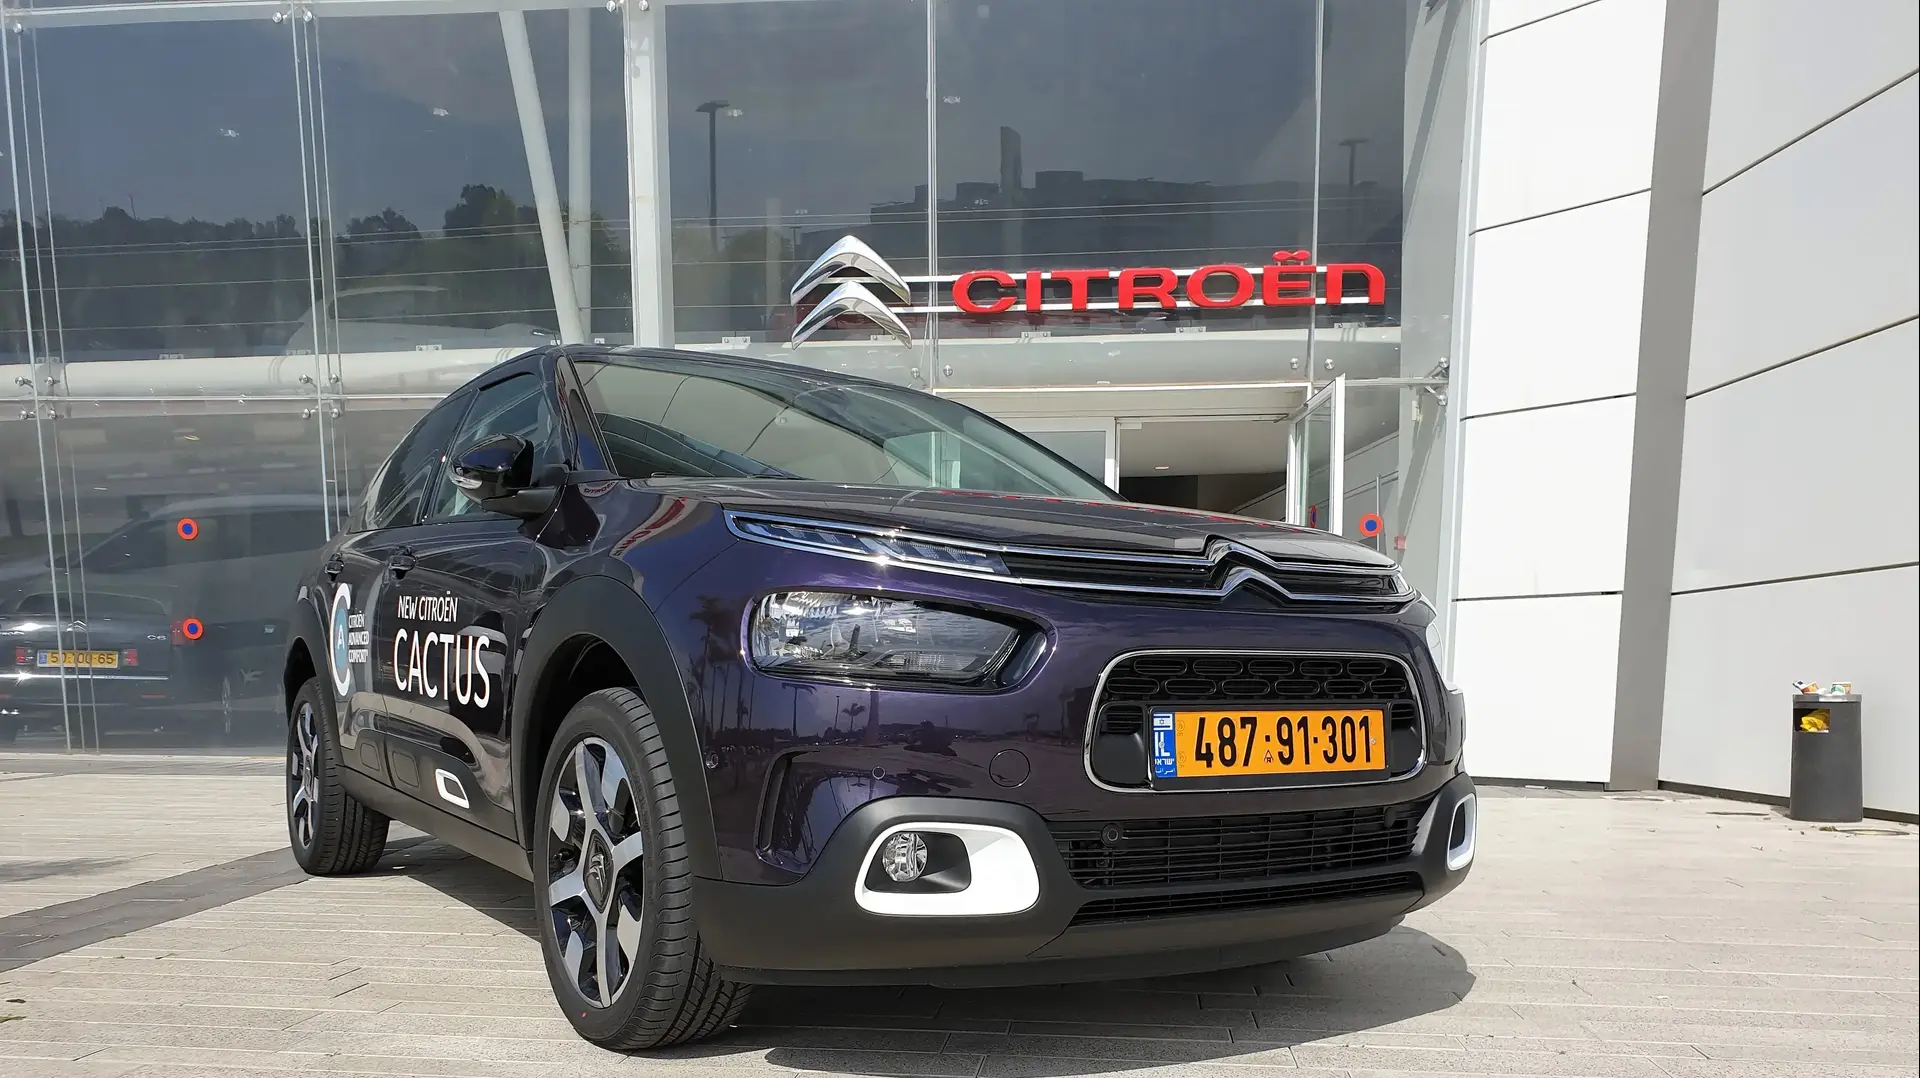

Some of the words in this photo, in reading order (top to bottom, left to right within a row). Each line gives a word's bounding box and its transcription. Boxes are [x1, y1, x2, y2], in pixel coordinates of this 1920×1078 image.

[952, 250, 1386, 314] CITROËN
[398, 595, 418, 620] NEW
[418, 590, 458, 622] CITROËN
[393, 628, 490, 708] CACTUS
[1154, 732, 1170, 757] IL
